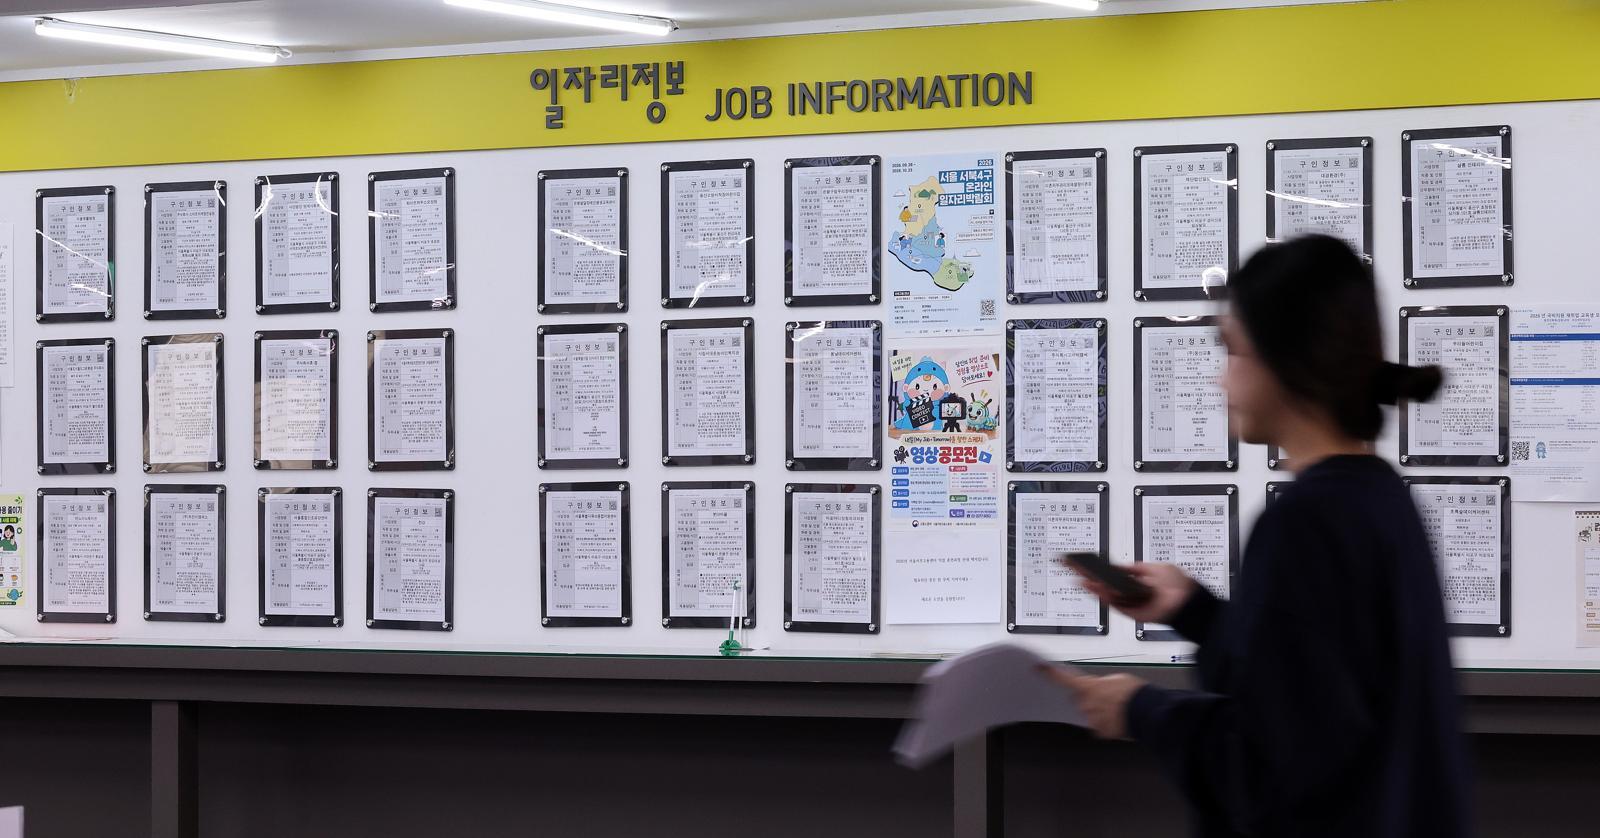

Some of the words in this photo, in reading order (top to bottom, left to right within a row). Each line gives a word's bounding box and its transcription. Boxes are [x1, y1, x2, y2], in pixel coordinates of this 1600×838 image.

[529, 60, 685, 129] 일자리정보
[705, 85, 772, 122] JOB
[786, 71, 1034, 118] INFORMATION
[940, 171, 957, 183] 서울
[960, 170, 993, 182] 서북4구
[966, 181, 993, 193] 온라인
[939, 193, 993, 206] 일자리박람회
[8, 505, 22, 515] 줄이기
